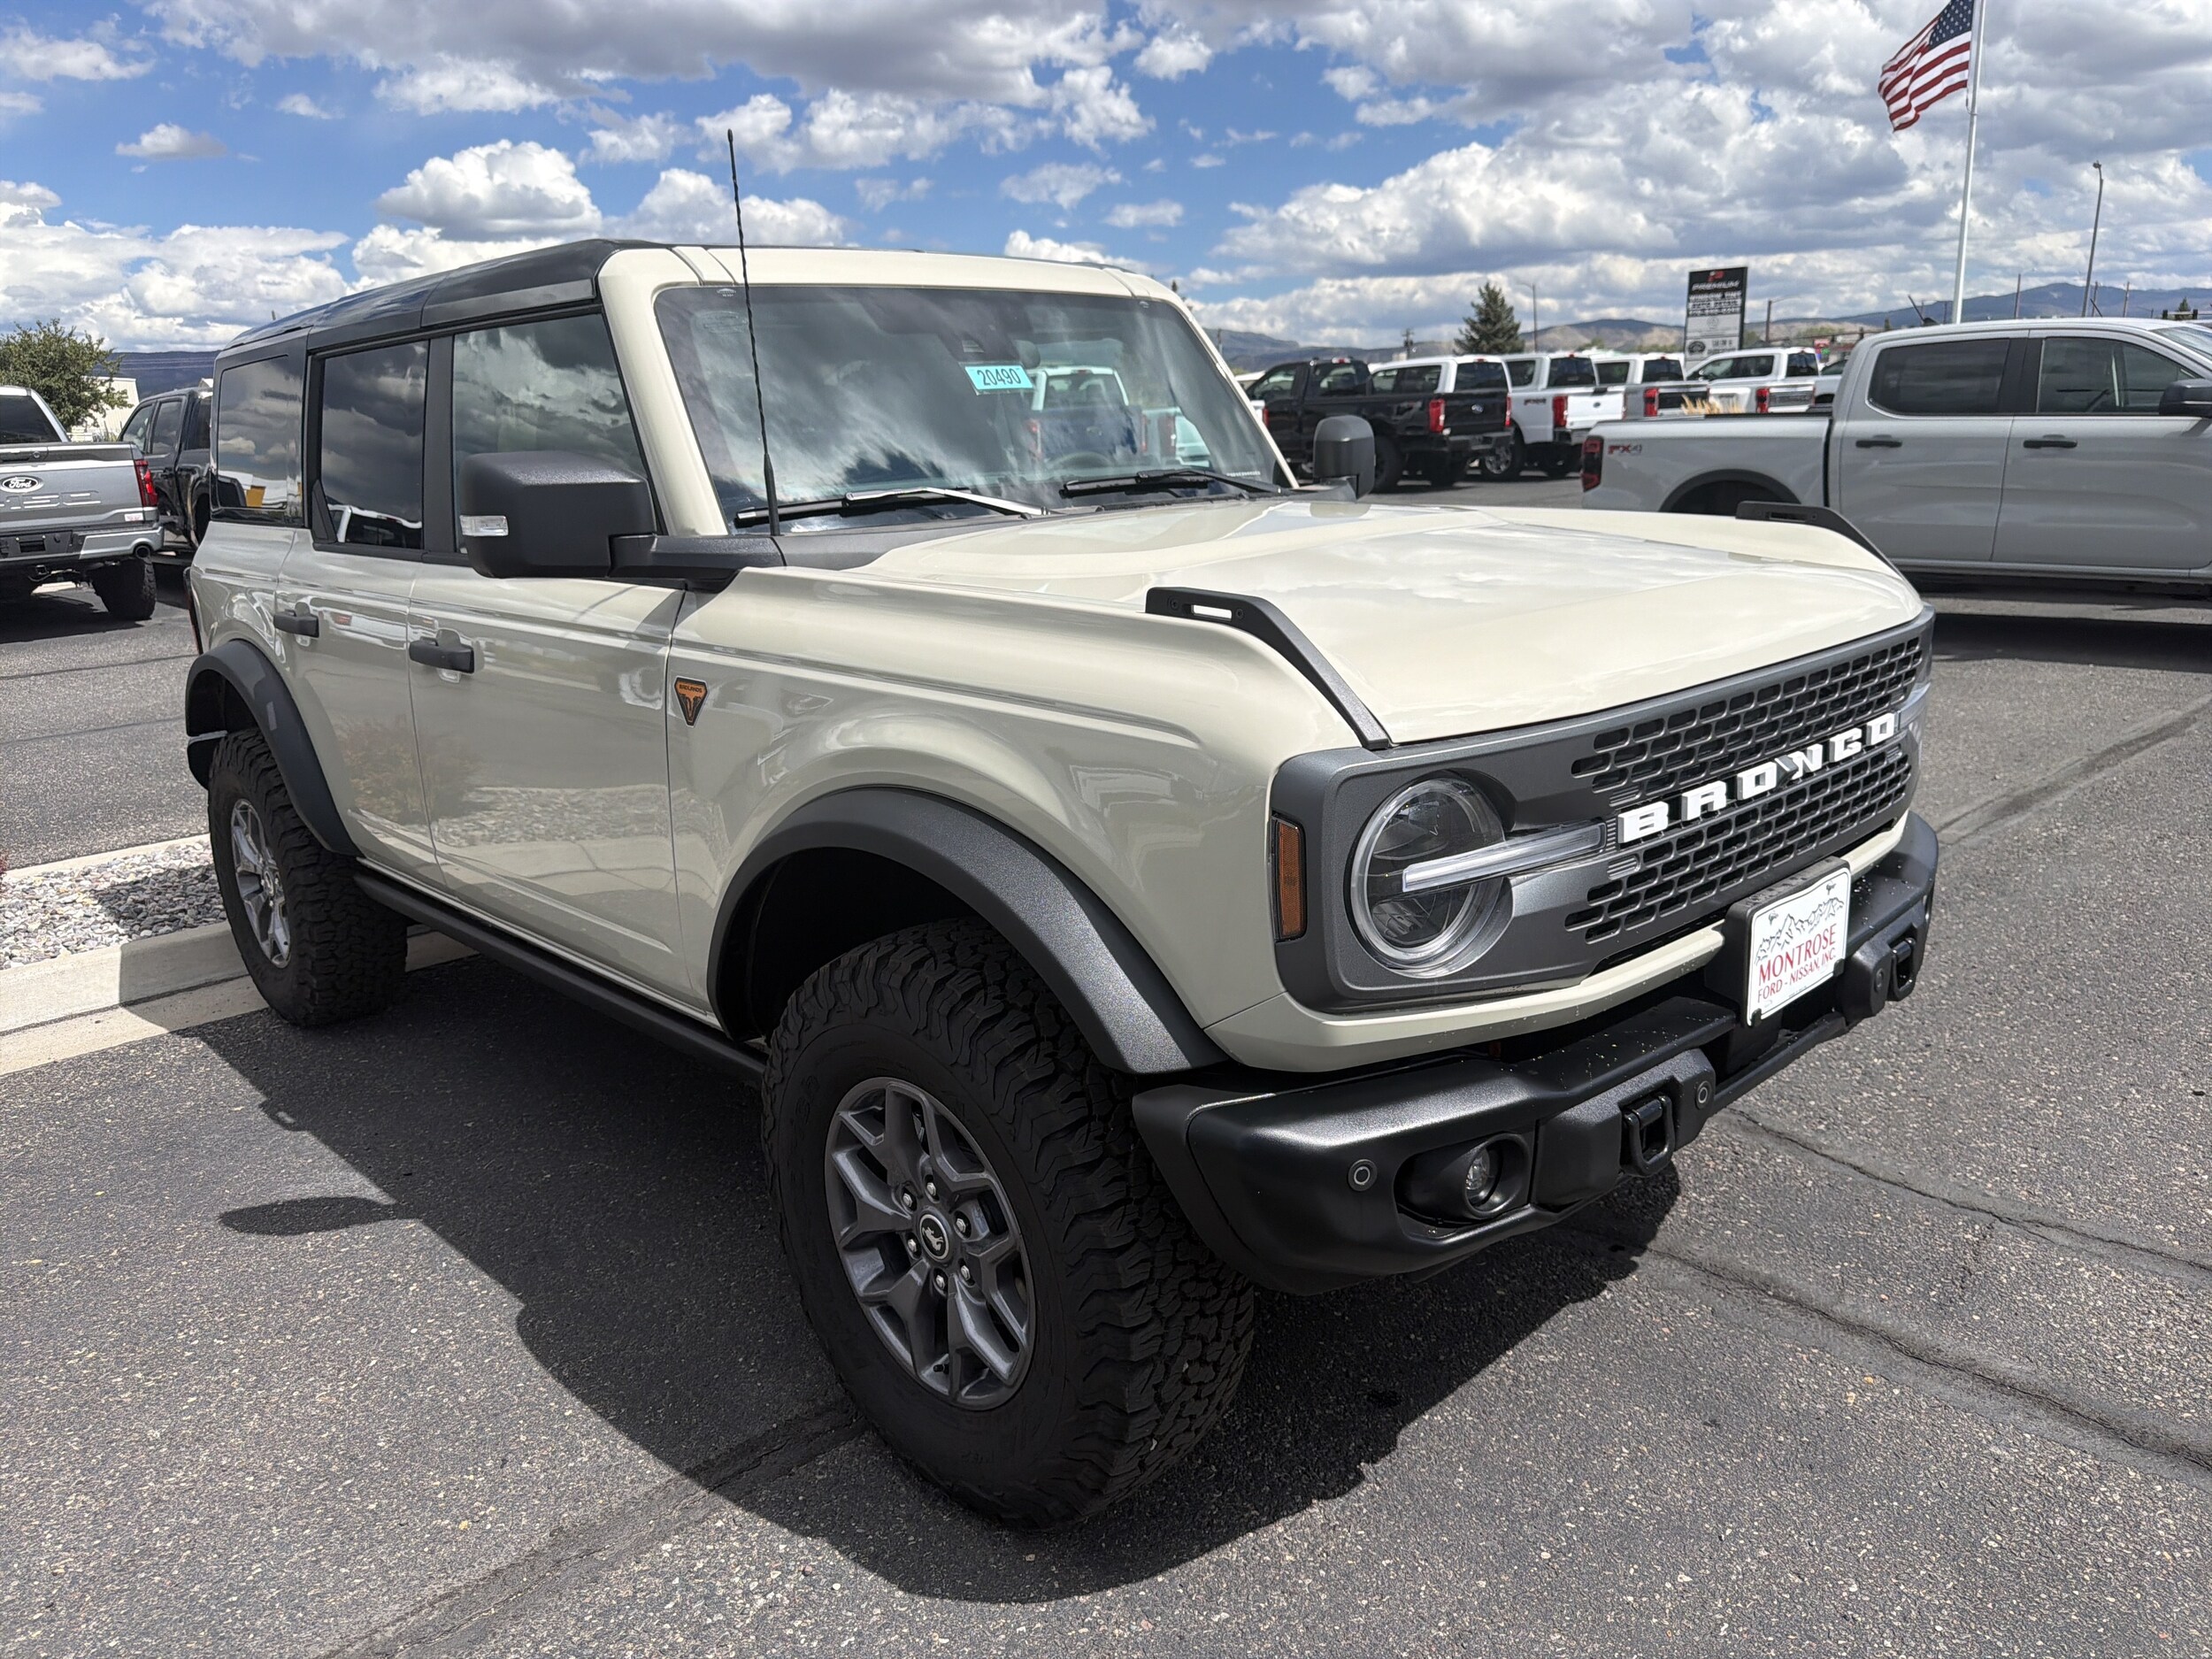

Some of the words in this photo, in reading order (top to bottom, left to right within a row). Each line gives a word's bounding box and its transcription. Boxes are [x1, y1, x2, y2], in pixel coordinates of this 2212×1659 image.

[1692, 280, 1740, 291] PREMIUM
[977, 367, 1021, 386] 20490
[1608, 444, 1642, 454] FX4
[9, 476, 32, 488] Ford
[1617, 711, 1895, 844] BRONCO
[1758, 923, 1837, 987] MONTROSE
[1757, 978, 1783, 1003] FORD
[1821, 947, 1837, 968] INC.
